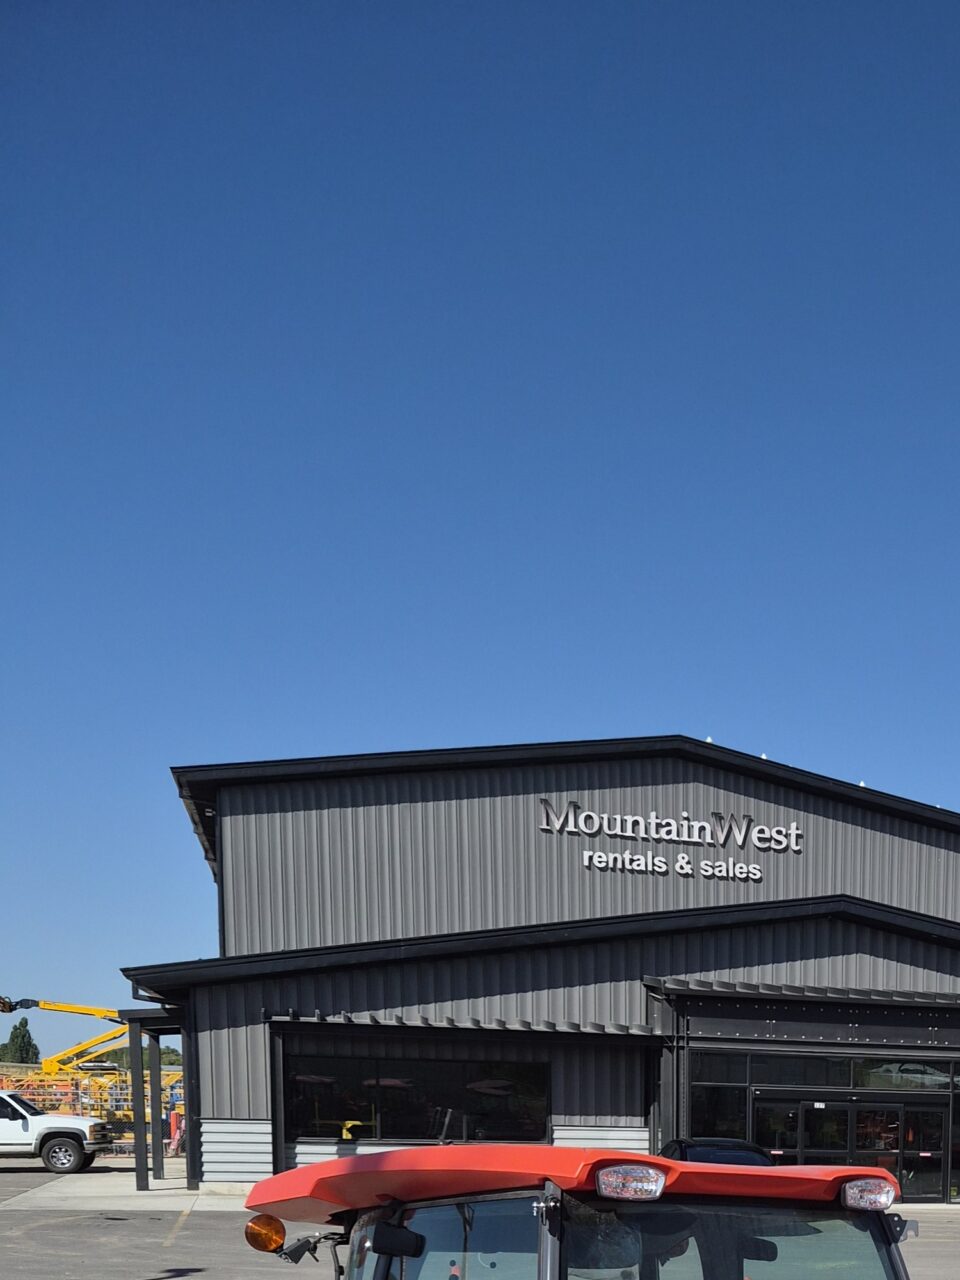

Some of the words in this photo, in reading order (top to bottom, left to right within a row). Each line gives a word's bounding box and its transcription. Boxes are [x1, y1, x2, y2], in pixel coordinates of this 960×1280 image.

[538, 798, 802, 851] MountainWest
[583, 850, 668, 873] rentals
[675, 853, 693, 875] &
[700, 857, 762, 880] sales
